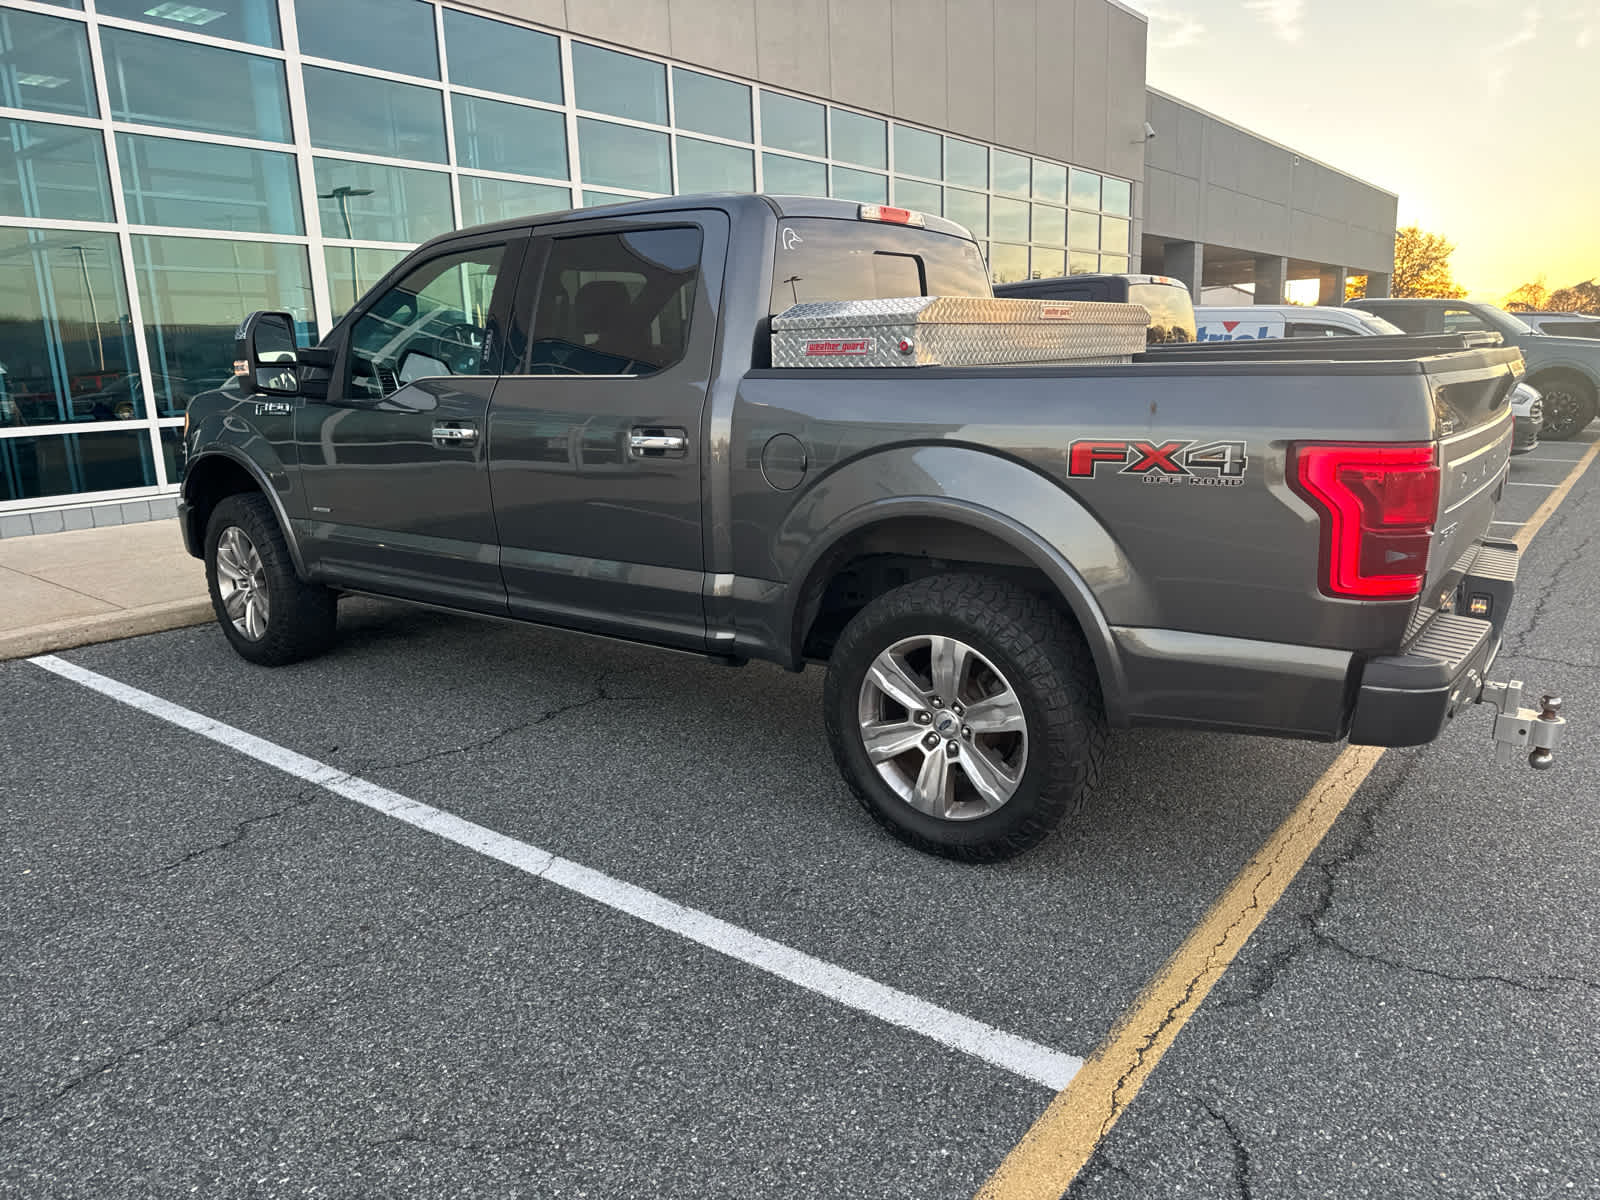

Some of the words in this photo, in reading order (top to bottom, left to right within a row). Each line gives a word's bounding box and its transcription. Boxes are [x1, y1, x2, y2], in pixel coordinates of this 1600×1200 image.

[808, 342, 840, 351] weather
[841, 342, 865, 353] guard
[1067, 438, 1248, 479] FX4
[1142, 475, 1182, 485] OFF
[1188, 476, 1244, 487] ROAD
